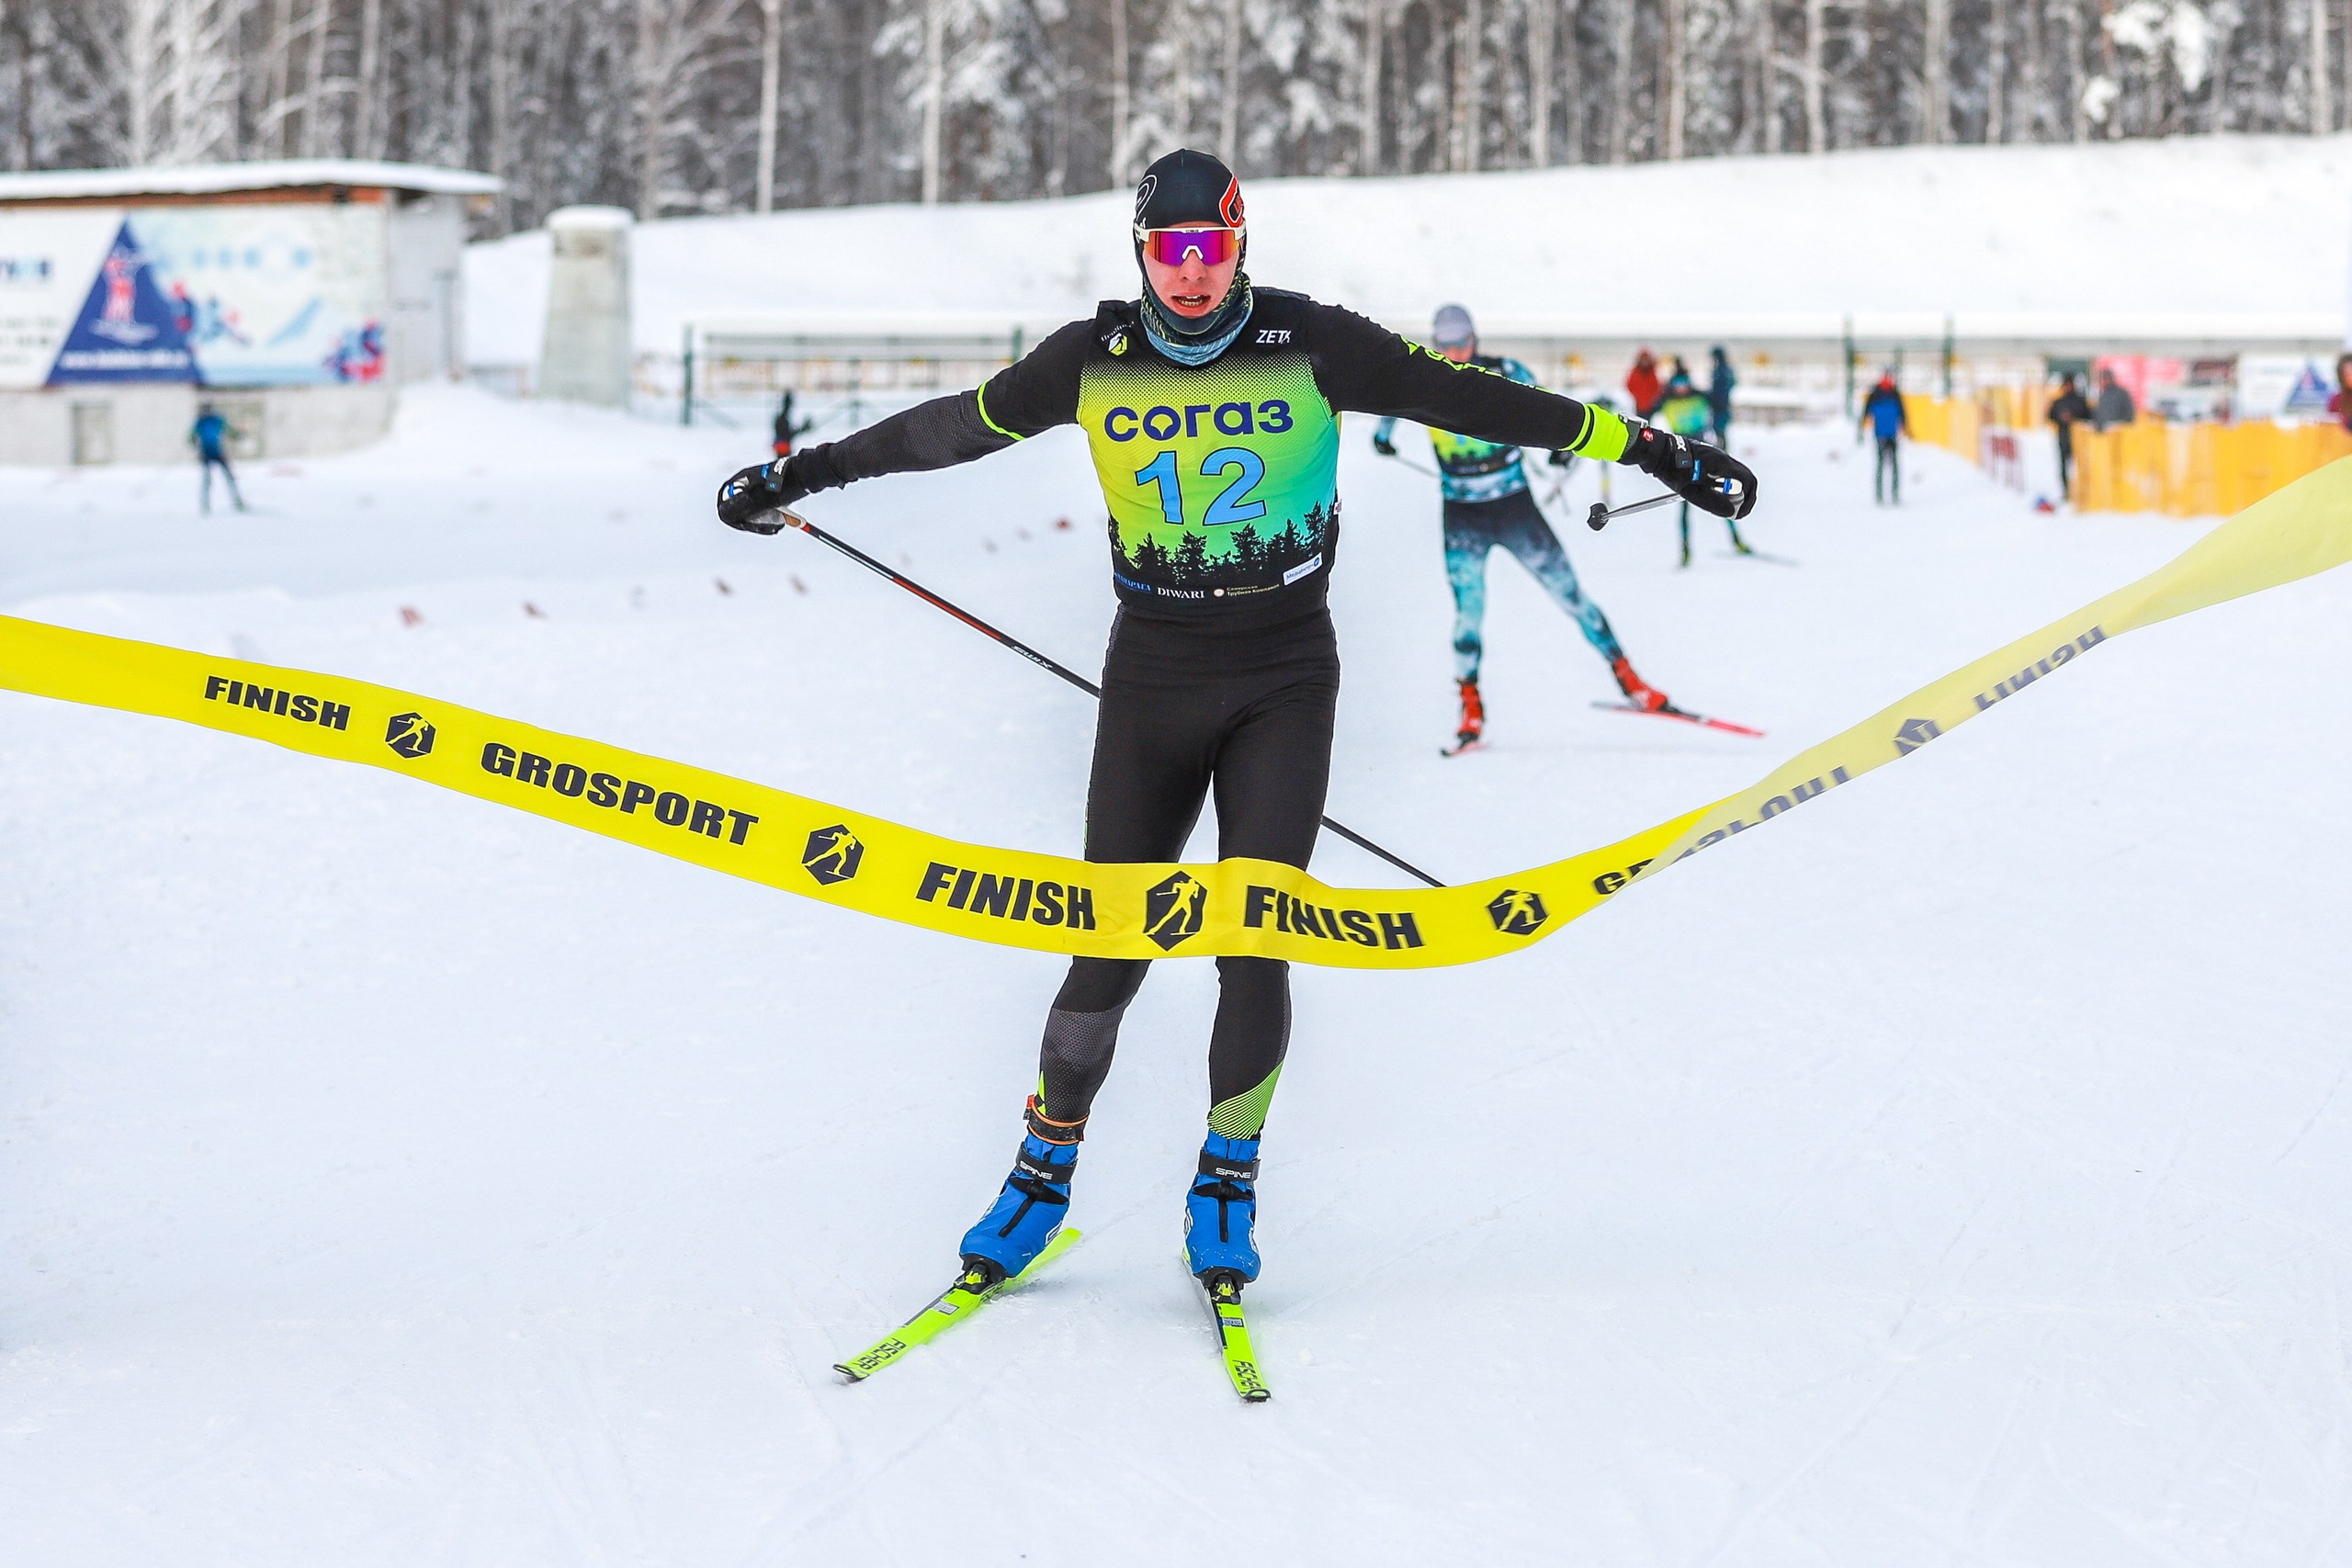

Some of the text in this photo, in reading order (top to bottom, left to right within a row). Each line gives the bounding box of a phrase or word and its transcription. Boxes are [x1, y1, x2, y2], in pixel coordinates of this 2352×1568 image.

[1135, 446, 1267, 526] 12
[1157, 586, 1205, 599] DIWARI
[204, 675, 351, 731] FINISH
[480, 741, 760, 845] GROSPORT
[914, 862, 1097, 931] FINISH
[1245, 885, 1427, 950] FINISH
[1019, 1160, 1054, 1180] SPINE
[1215, 1167, 1252, 1179] SPINE
[852, 1337, 907, 1371] FISCHER
